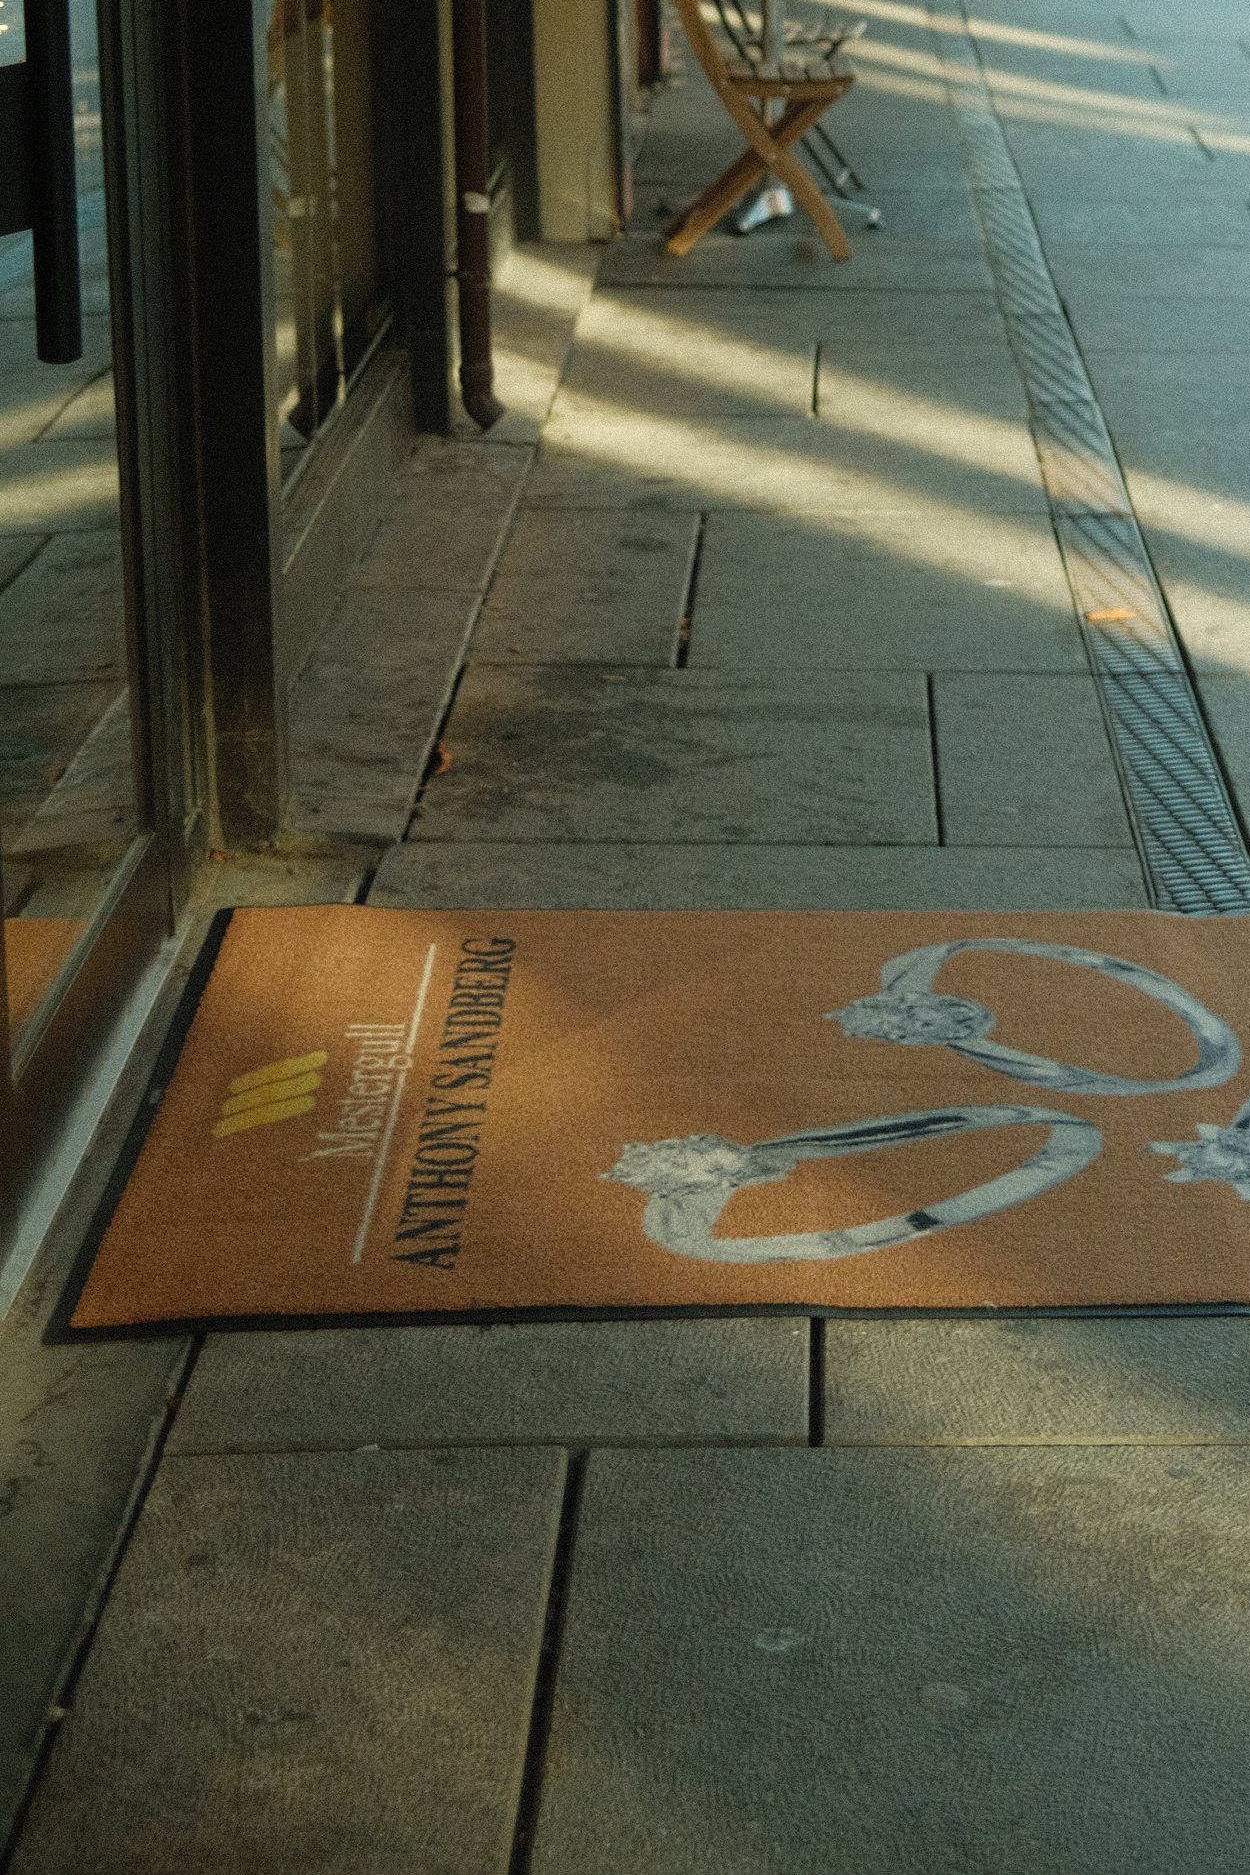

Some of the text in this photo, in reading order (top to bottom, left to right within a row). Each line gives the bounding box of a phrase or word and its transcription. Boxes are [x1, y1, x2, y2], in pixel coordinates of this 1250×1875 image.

[298, 1022, 414, 1162] Mestergull
[391, 935, 517, 1271] ANTHONY SANDBERG
